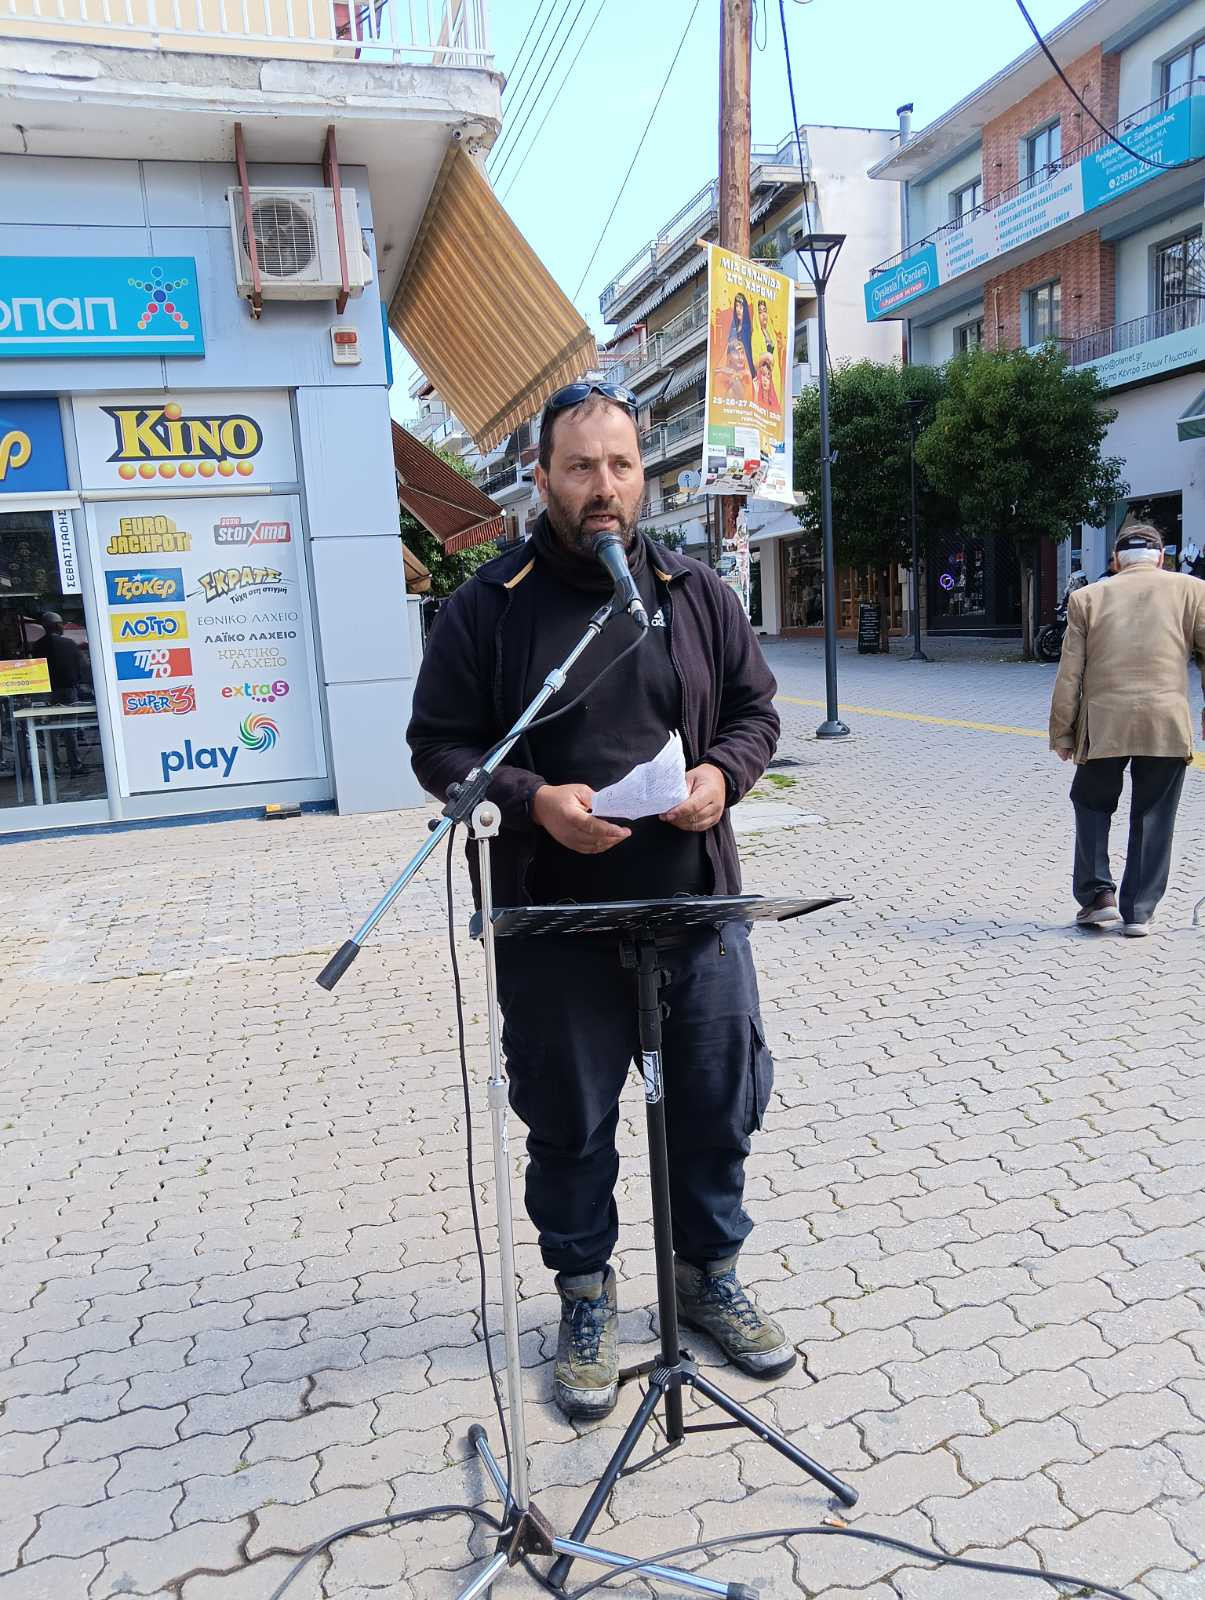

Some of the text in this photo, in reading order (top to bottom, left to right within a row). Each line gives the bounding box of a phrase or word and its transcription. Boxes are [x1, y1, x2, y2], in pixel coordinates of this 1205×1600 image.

[1141, 359, 1163, 371] Ξένων
[1164, 346, 1198, 364] Γλωσσών
[120, 515, 169, 536] EURO
[107, 532, 188, 556] JACKPOT
[121, 616, 178, 638] ΛΟΤΤΟ
[198, 611, 298, 627] ΕΘΝΙΚΟ ΛΑΧΕΙΟ
[205, 630, 296, 644] ΛΑΪΚΟ ΛΑΧΕΙΟ
[218, 648, 280, 660] ΚΡΑΤΙΚΟ
[231, 657, 287, 670] ΛΑΧΕΙΟ
[161, 739, 238, 783] play
